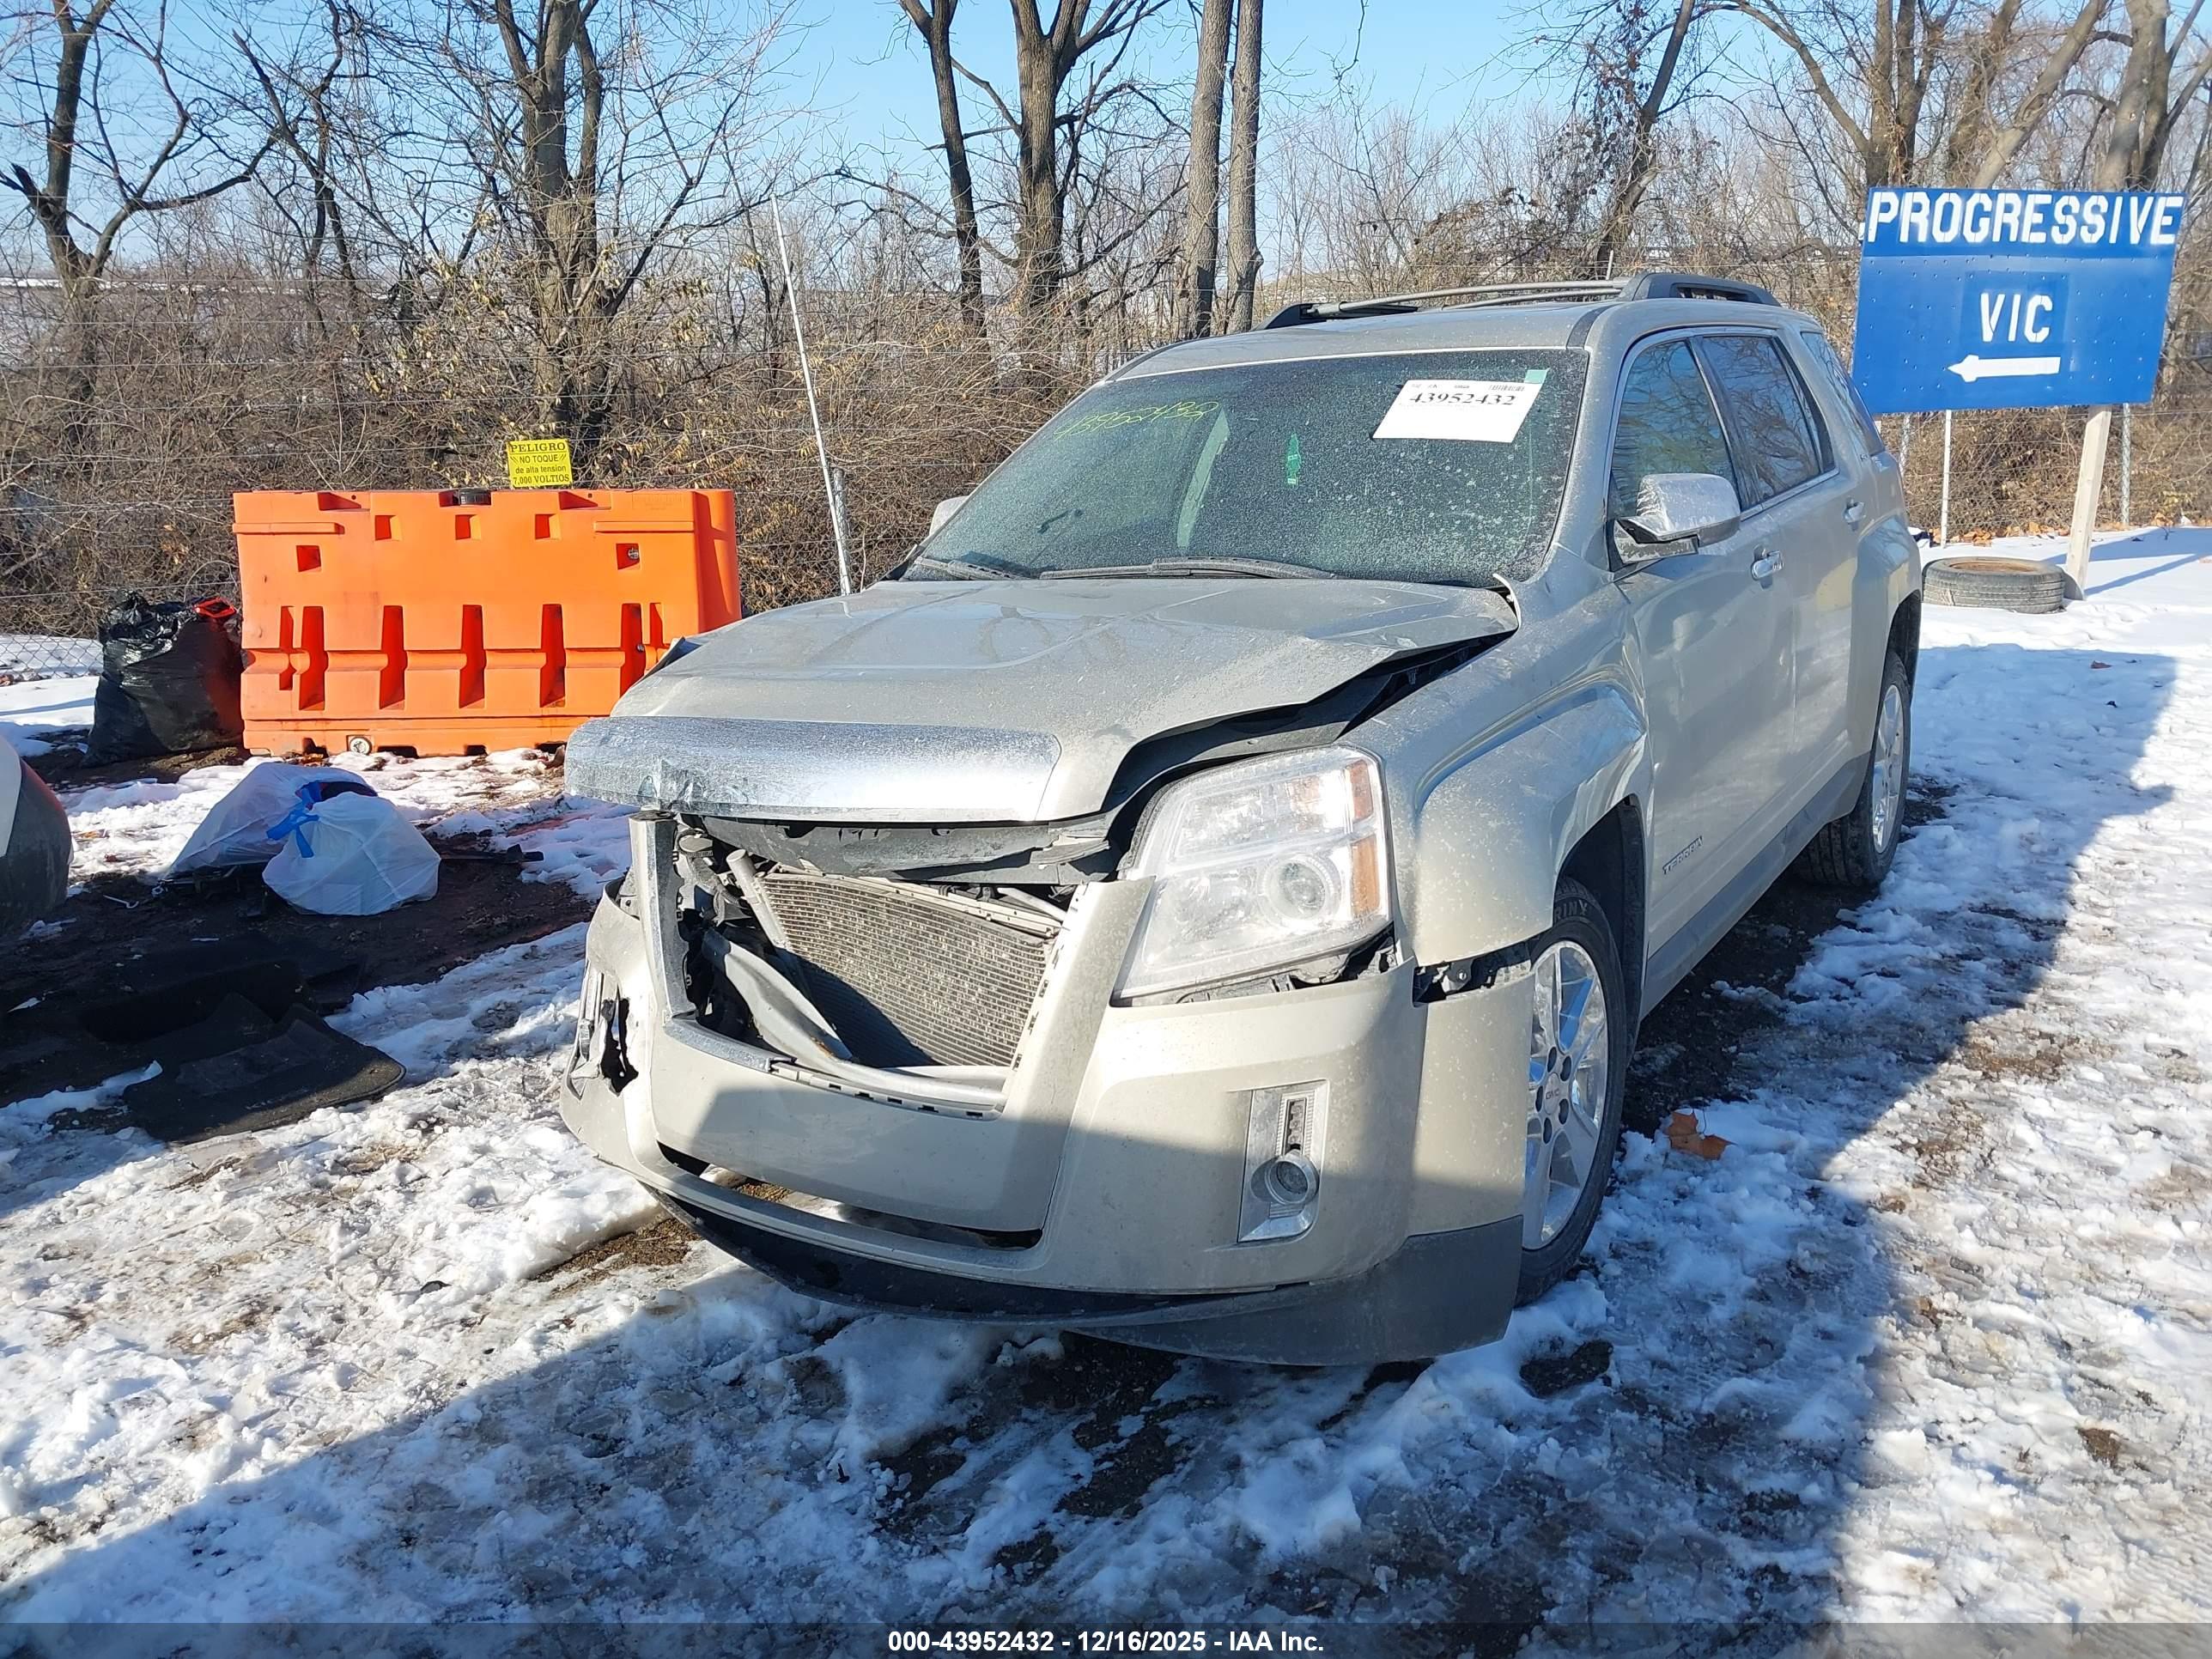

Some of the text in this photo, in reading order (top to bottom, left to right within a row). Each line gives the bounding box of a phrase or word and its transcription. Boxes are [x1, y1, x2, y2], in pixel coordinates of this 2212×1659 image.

[1868, 191, 2184, 245] PROGRESSIVE
[1979, 292, 2053, 343] VIC
[1410, 392, 1516, 405] 43952432
[511, 442, 566, 453] PELIGRO
[520, 453, 559, 464] NO TOQUE
[540, 465, 567, 473] tension
[513, 473, 570, 485] 7,000 VOLTIOS
